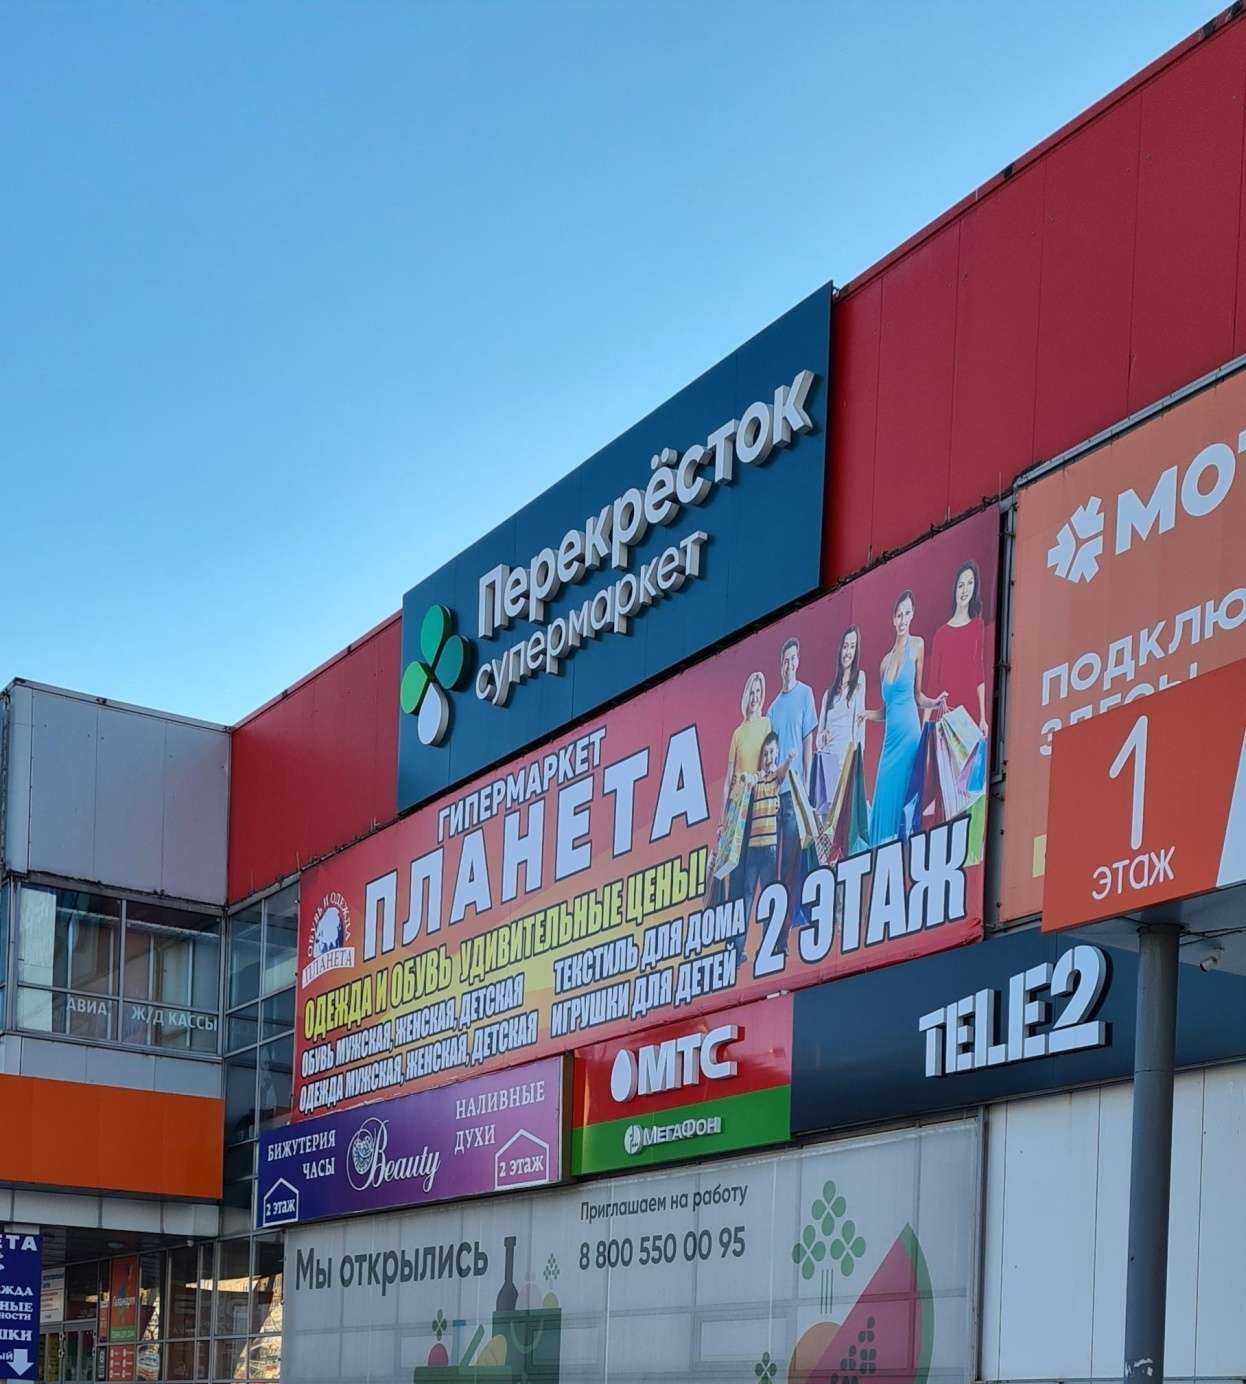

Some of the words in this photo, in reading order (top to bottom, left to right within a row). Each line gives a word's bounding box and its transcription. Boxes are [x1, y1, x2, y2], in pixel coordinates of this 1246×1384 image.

[478, 369, 814, 639] Перекрёсток
[475, 530, 708, 707] супермаркет
[1041, 588, 1246, 705] ПОДКЛЮ
[438, 727, 606, 842] ГИПЕРМАРКЕТ
[1109, 714, 1148, 850] 1
[363, 725, 709, 961] ПЛАНЕТА
[1091, 846, 1175, 900] этаж
[460, 879, 623, 985] УДИВИТЕЛЬНЫЕ
[626, 845, 707, 925] ЦЕНЫ!
[753, 881, 789, 979] 2
[800, 815, 971, 963] ЭТАЖ
[303, 950, 354, 983] ПЛАНЕТА
[554, 934, 639, 994] ТЕКСТИЛЬ
[641, 917, 683, 971] ДЛЯ
[684, 898, 746, 959] ДОМА
[130, 1006, 165, 1025] Ж/Д
[168, 1012, 217, 1031] КАССЫ
[302, 1043, 335, 1077] ОБУВЬ
[335, 1020, 393, 1066] МУЖСКАЯ,
[394, 997, 458, 1045] ЖЕНСКАЯ,
[459, 973, 525, 1028] ДЕТСКАЯ
[304, 975, 372, 1042] ОДЕЖДА
[375, 968, 388, 1014] И
[391, 944, 452, 1009] ОБУВЬ
[551, 980, 630, 1037] ИГРУШКИ
[631, 966, 674, 1019] ДЛЯ
[674, 942, 737, 1007] ДЕТЕЙ
[919, 944, 1107, 1078] TELE2
[299, 1076, 344, 1114] ОДЕЖДА
[345, 1052, 405, 1098] МУЖСКАЯ,
[405, 1030, 470, 1080] ЖЕНСКАЯ,
[471, 1010, 538, 1066] ДЕТСКАЯ
[638, 1024, 738, 1095] МТС
[455, 1080, 545, 1120] НАЛИВНЫЕ
[267, 1129, 336, 1161] БИЖУТЕРИЯ
[302, 1157, 335, 1180] ЧАСЫ
[347, 1117, 441, 1192] Beauty
[454, 1124, 496, 1154] ДУХИ
[499, 1162, 507, 1177] 2
[508, 1155, 544, 1175] этаж
[266, 1203, 272, 1216] 2
[580, 1193, 666, 1223] Приглашаем
[670, 1193, 688, 1210] на
[692, 1184, 748, 1212] работу
[0, 1234, 38, 1251] ТА
[296, 1248, 332, 1290] Мы
[339, 1241, 489, 1296] открылись
[579, 1242, 590, 1270] 8
[595, 1237, 633, 1269] 800
[639, 1233, 677, 1265] 550
[683, 1230, 712, 1262] 00
[718, 1226, 746, 1258] 95
